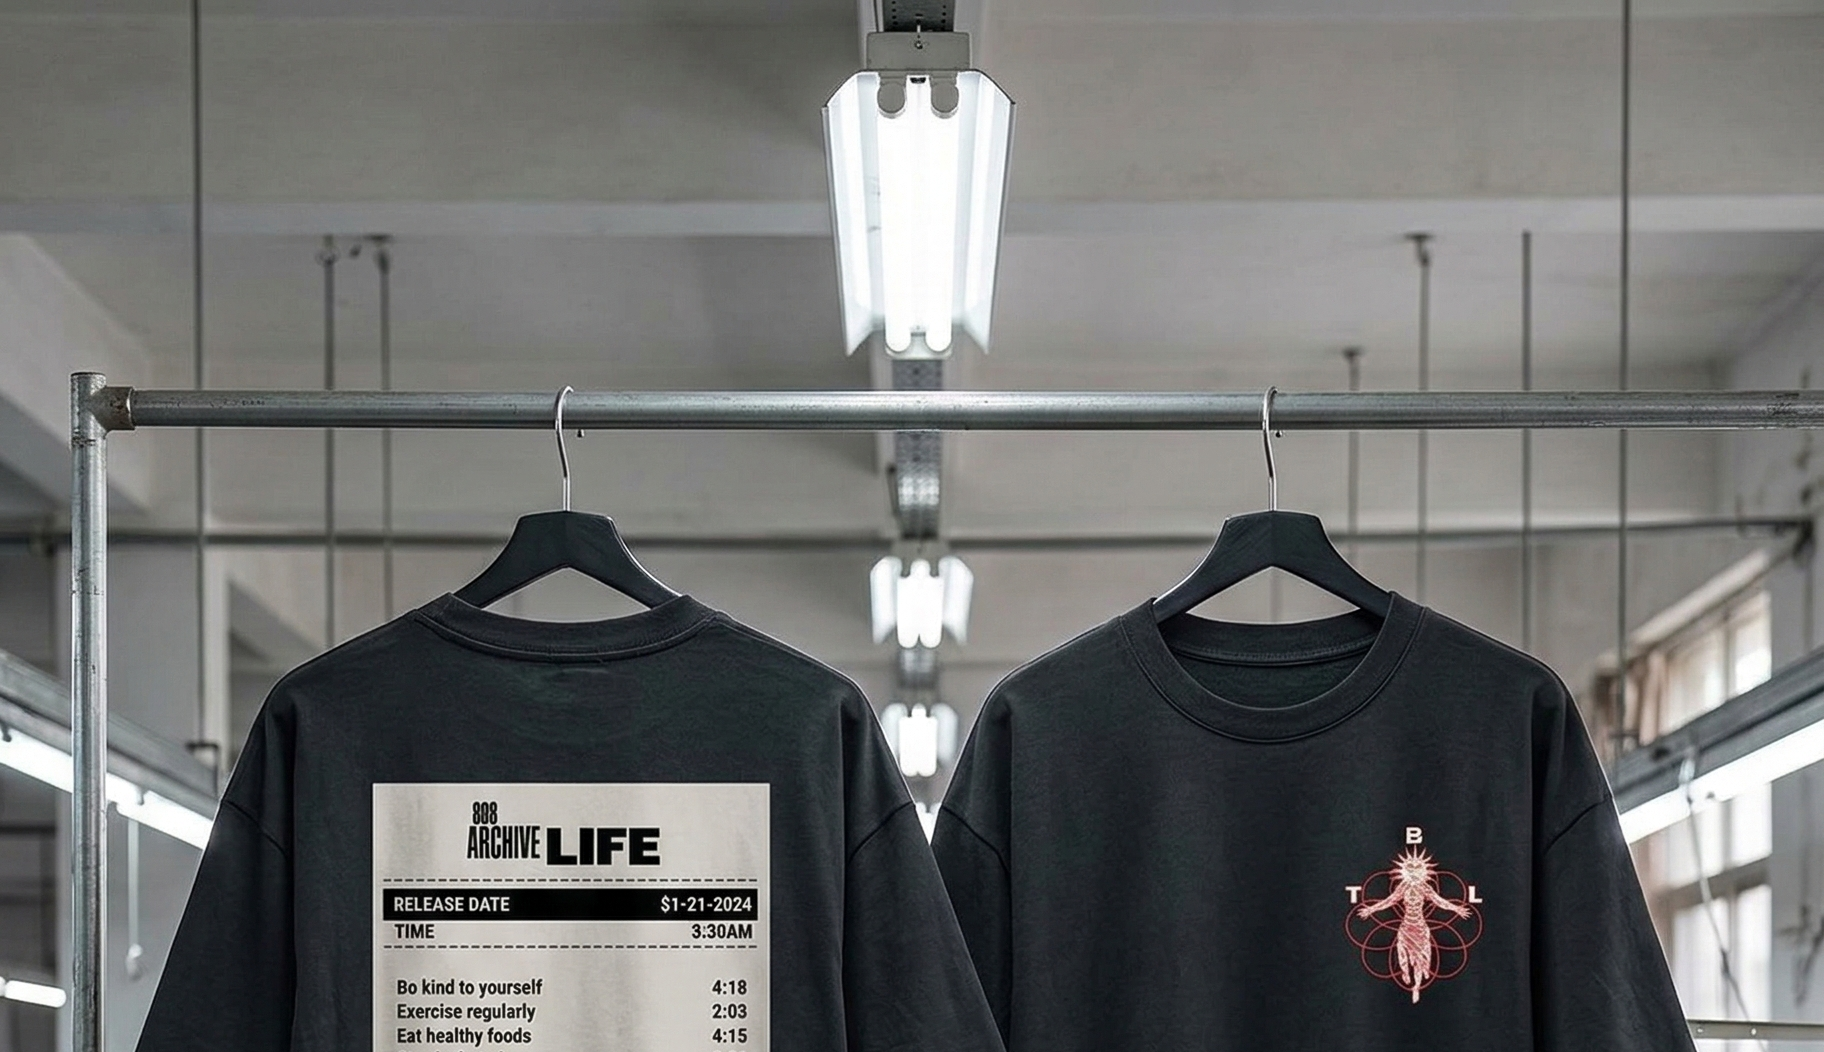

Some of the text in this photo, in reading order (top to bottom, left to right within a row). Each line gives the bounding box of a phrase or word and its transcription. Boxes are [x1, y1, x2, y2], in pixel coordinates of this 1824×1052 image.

[472, 801, 498, 825] 808
[1405, 826, 1424, 844] B
[467, 825, 661, 866] ARCHIVE LIFE
[394, 894, 752, 913] RELEASE DATE $1-21-2024
[1345, 885, 1362, 904] T
[1468, 885, 1483, 904] L
[394, 923, 753, 939] TIME 3:30AM
[422, 978, 455, 995] kind
[458, 980, 475, 995] to
[478, 978, 543, 999] yourself
[712, 979, 748, 995] 4:18
[397, 1002, 748, 1023] Exercise regularly 2:03
[397, 1026, 748, 1048] Eat healthy foods 4:15
